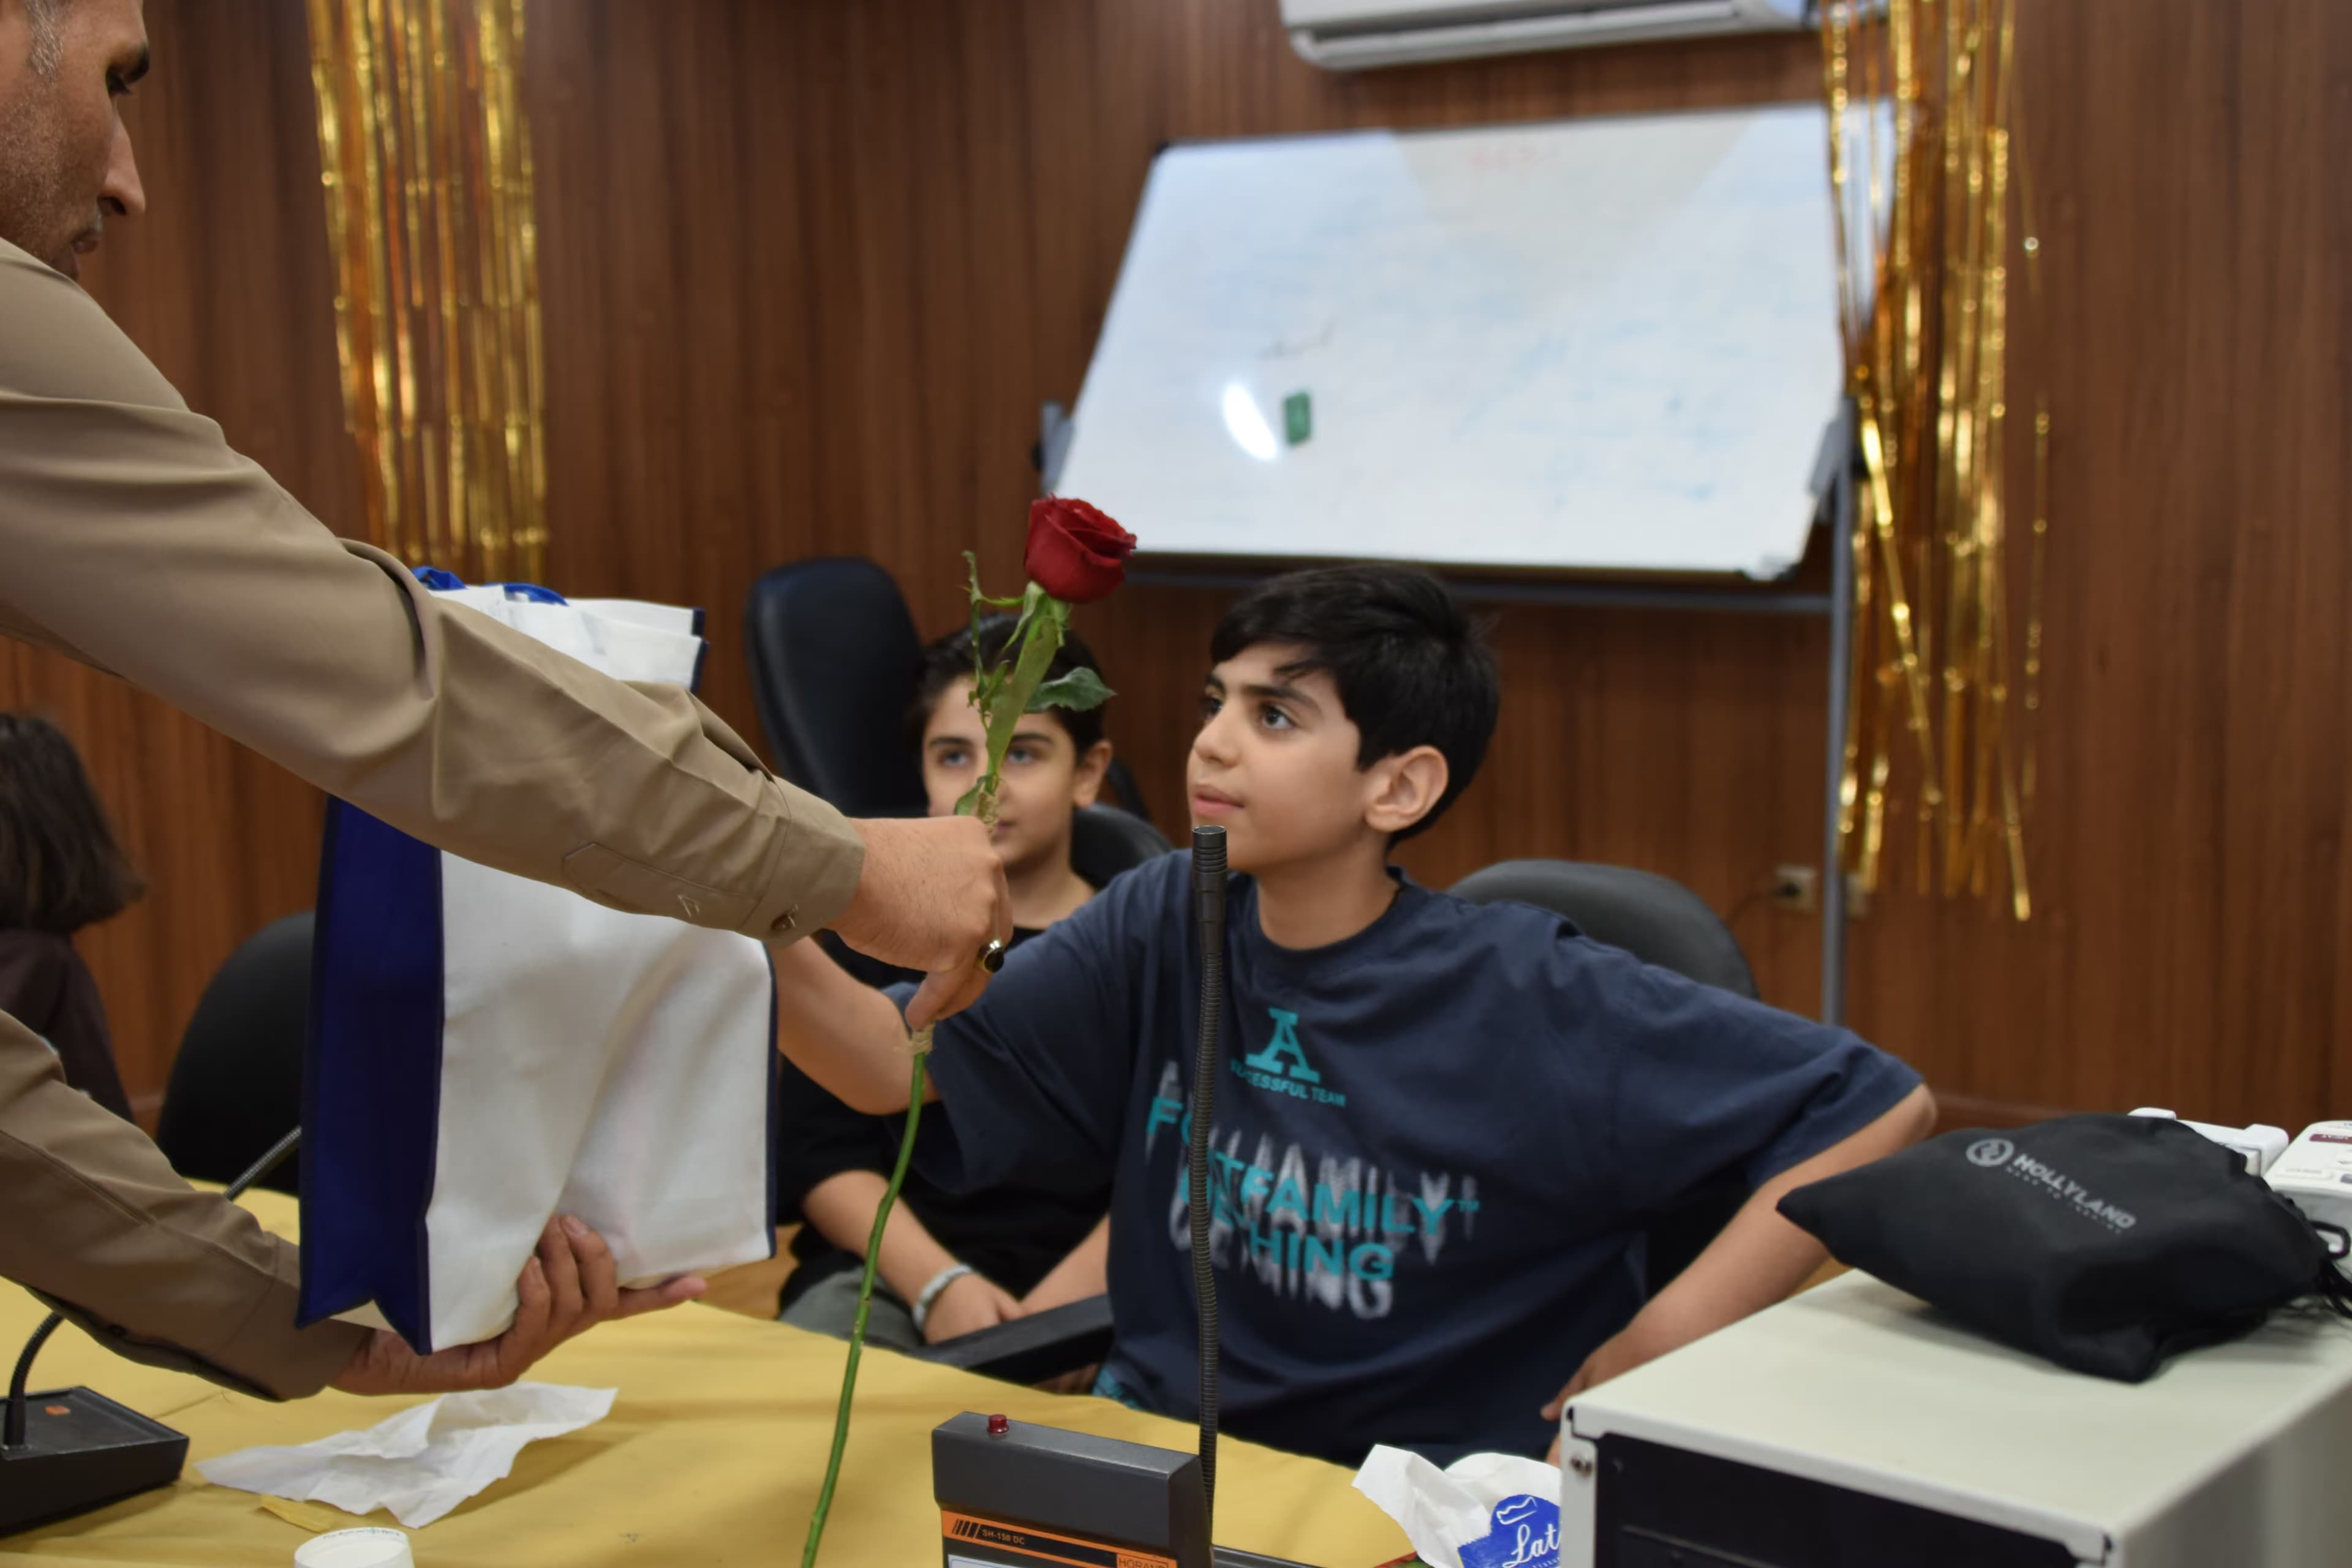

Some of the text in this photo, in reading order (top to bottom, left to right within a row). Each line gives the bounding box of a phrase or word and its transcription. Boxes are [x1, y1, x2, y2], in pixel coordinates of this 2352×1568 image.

[1245, 1007, 1321, 1084] A
[1311, 1085, 1346, 1107] TEAM
[2012, 1153, 2137, 1229] HOLLYLAND
[1502, 1523, 1561, 1568] Lat
